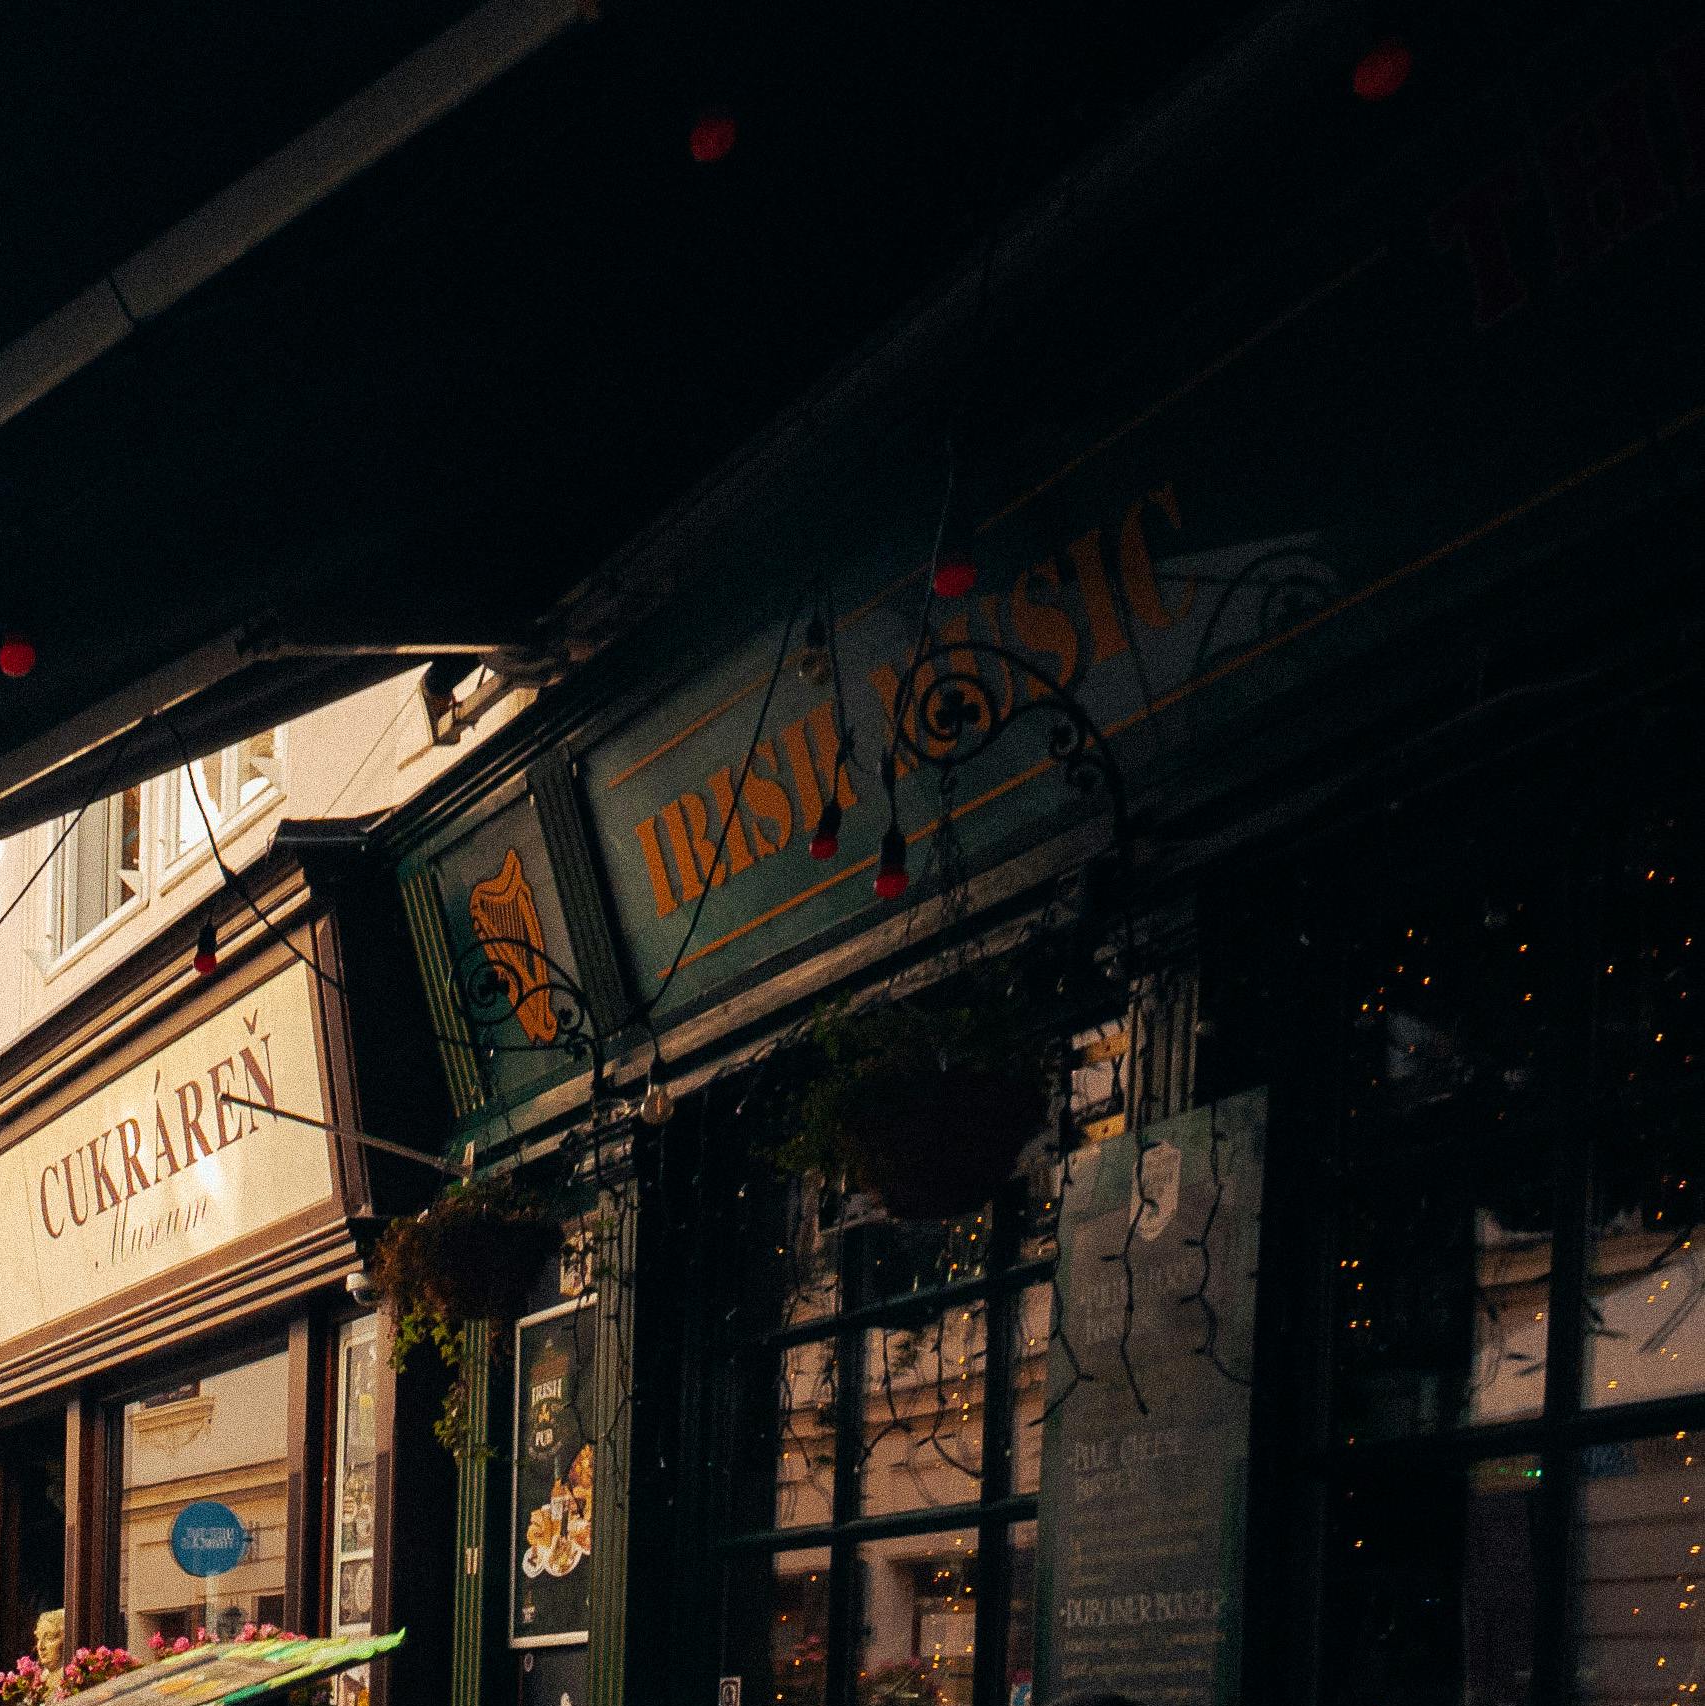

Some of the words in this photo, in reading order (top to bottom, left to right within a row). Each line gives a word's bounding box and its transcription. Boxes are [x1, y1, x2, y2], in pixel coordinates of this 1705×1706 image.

[635, 697, 857, 918] IRISH
[869, 480, 1197, 776] MUSIC
[39, 1008, 279, 1240] CUKRÁREŇ
